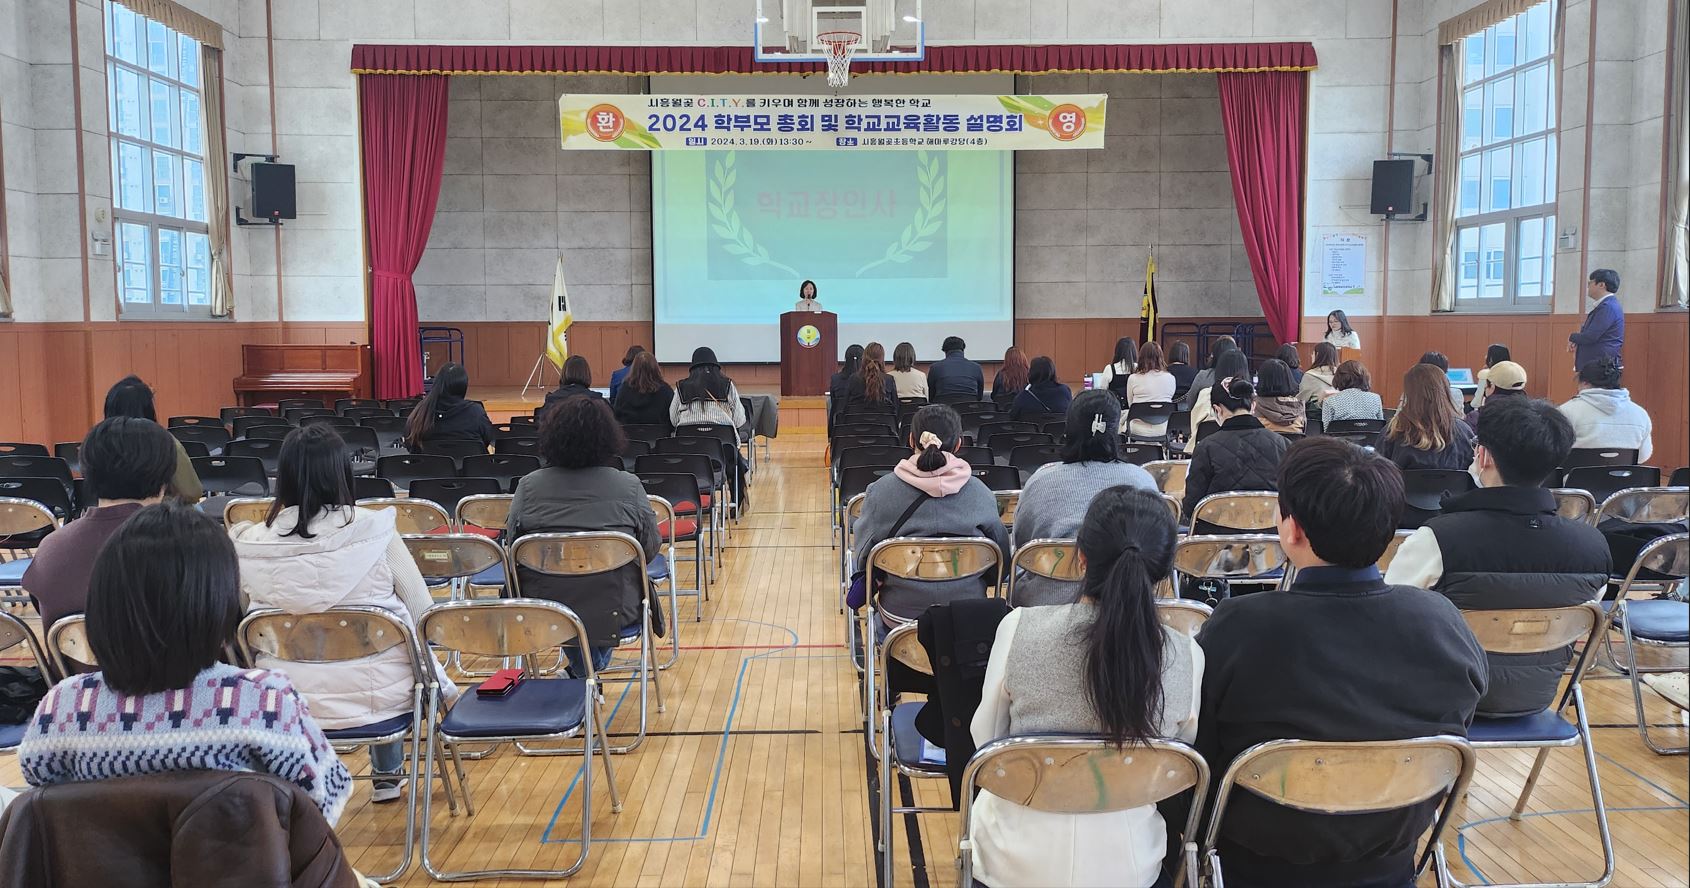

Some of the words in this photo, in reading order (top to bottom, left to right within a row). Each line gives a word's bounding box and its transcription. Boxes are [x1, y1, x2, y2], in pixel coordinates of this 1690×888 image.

[648, 98, 694, 108] 시흥월곶
[759, 98, 794, 108] 키우며
[797, 98, 820, 108] 함께
[822, 98, 869, 108] 성장하는
[872, 98, 906, 108] 행복한
[909, 98, 932, 108] 학교
[596, 111, 615, 133] 환
[647, 113, 708, 132] 2024
[713, 113, 772, 132] 학부모
[776, 113, 815, 132] 총회
[820, 113, 839, 132] 및
[844, 113, 960, 132] 학교교육활동
[966, 113, 1023, 132] 설명회
[1058, 112, 1076, 132] 영
[862, 137, 924, 146] 시흥월곶초등학교
